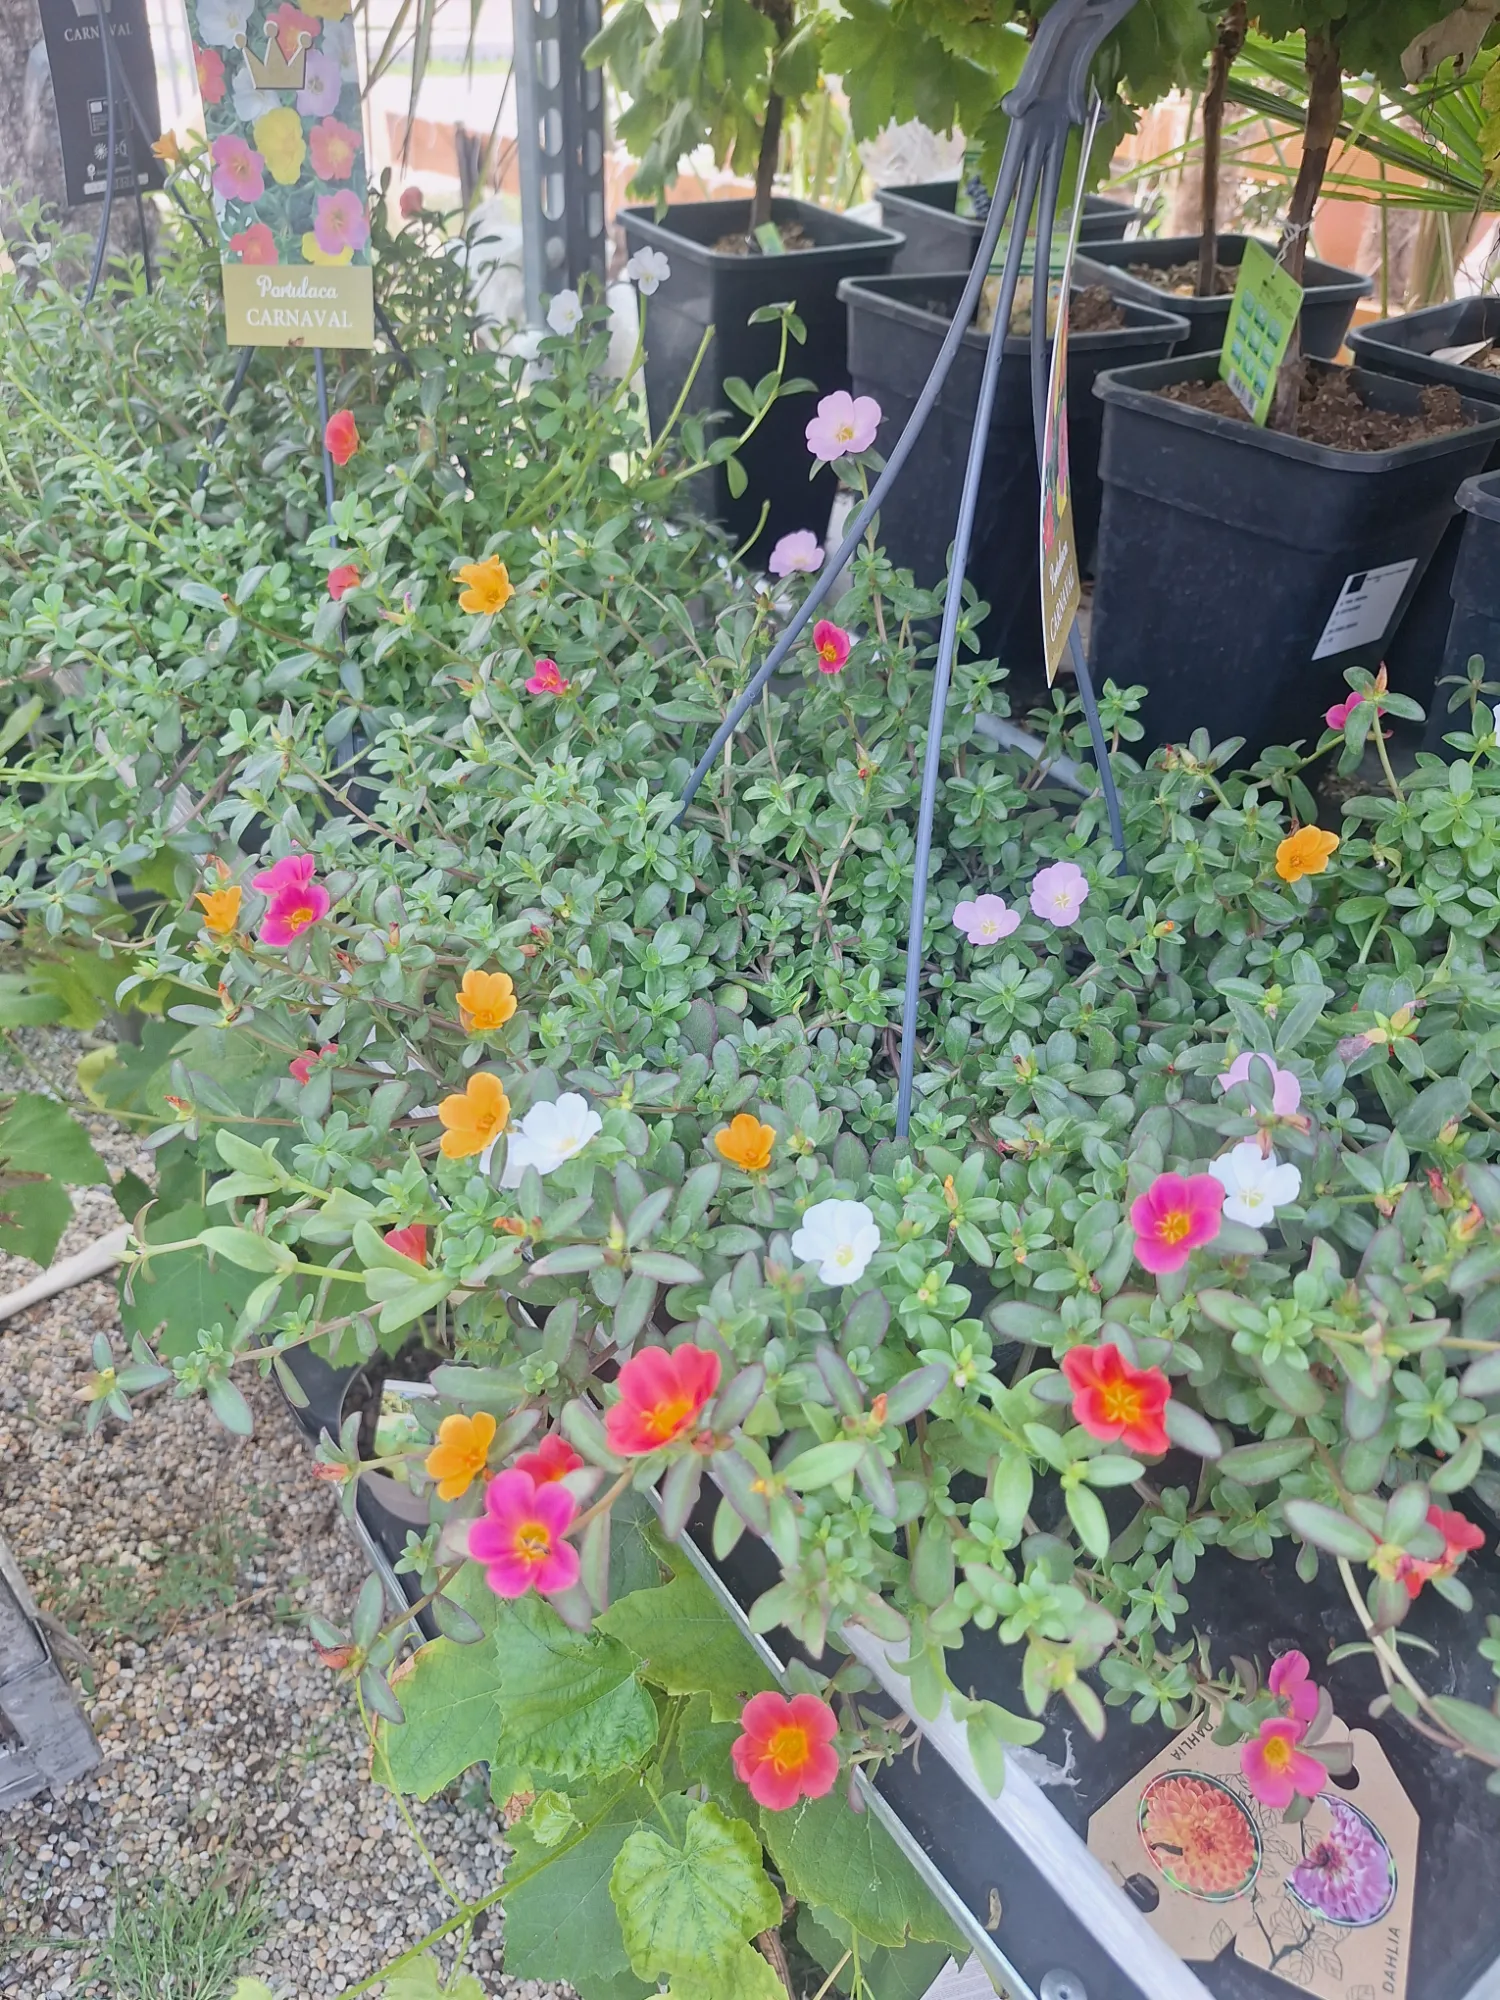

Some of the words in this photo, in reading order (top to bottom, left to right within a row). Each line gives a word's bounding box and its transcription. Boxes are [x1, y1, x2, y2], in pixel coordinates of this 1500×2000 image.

[64, 22, 133, 42] CARNVAL
[256, 274, 338, 299] Portulaca
[246, 308, 353, 328] CARNAVAL
[1170, 1722, 1214, 1761] DAHLIA
[1382, 1926, 1401, 1994] DAHLIA
